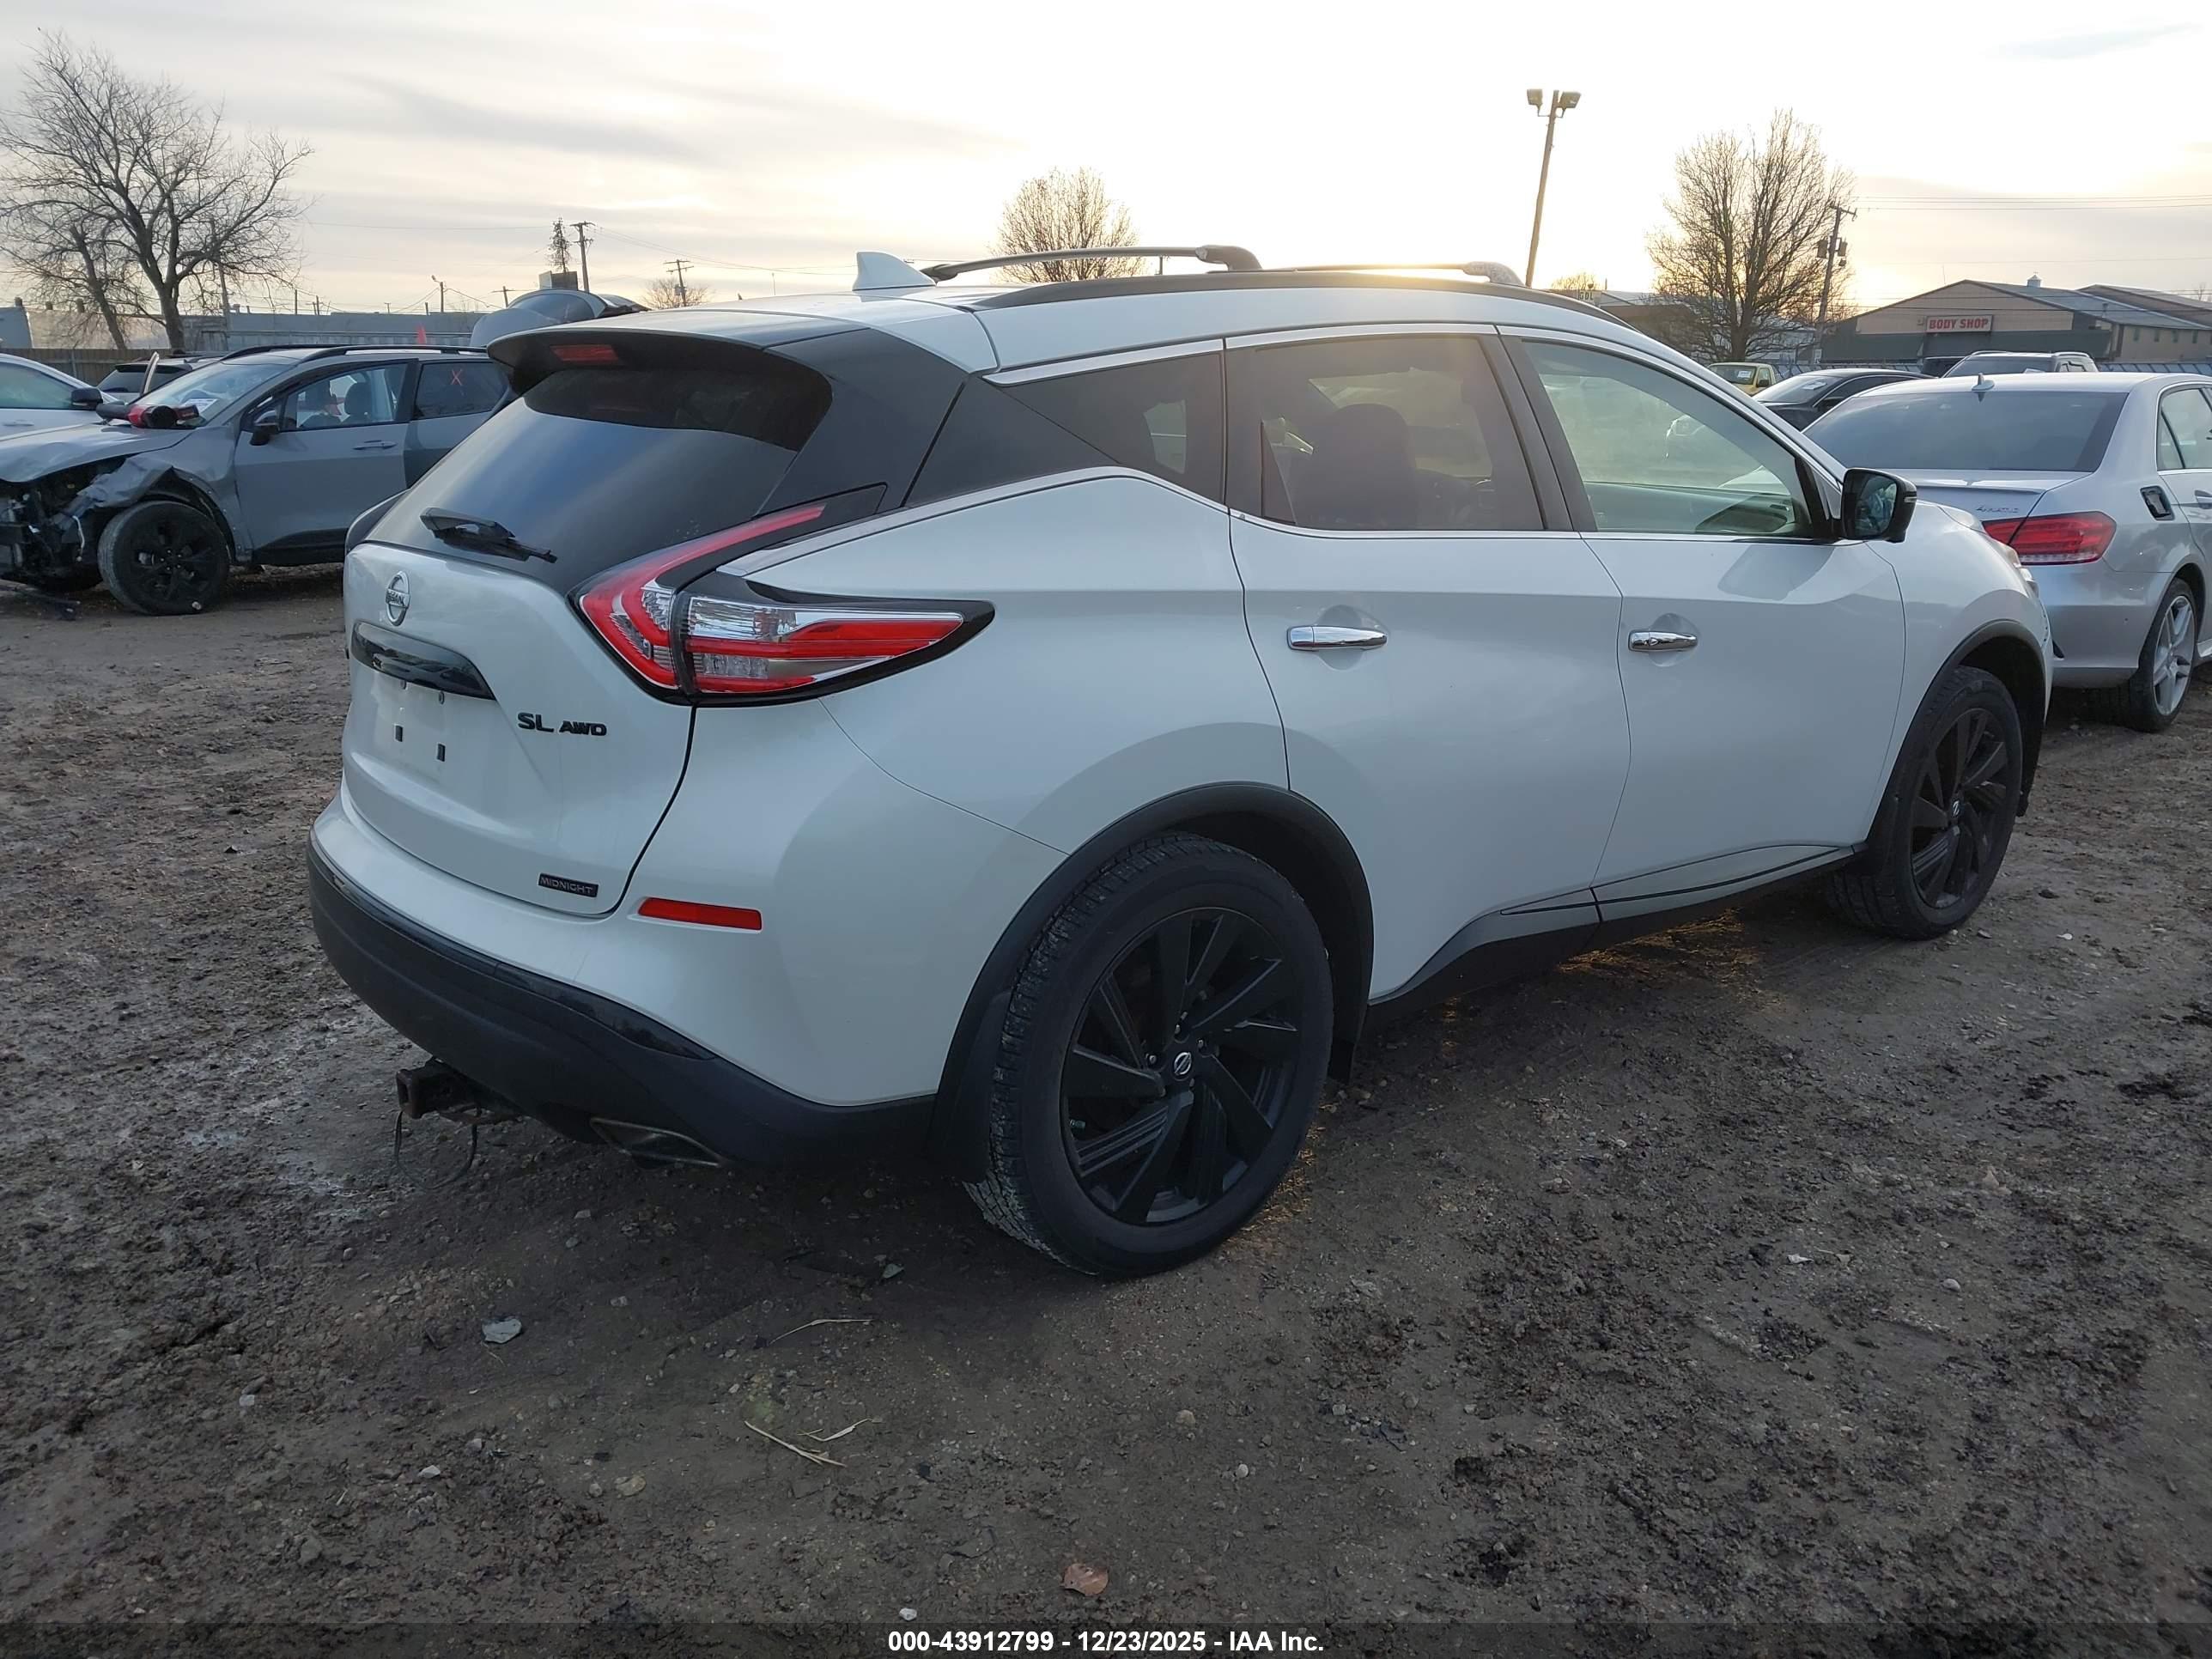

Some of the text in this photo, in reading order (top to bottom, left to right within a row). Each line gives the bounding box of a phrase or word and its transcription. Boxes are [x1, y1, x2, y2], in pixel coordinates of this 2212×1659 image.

[1929, 318, 1989, 330] BODY SHOP
[517, 712, 607, 737] SL AWD
[540, 876, 593, 895] MIDNIGHT
